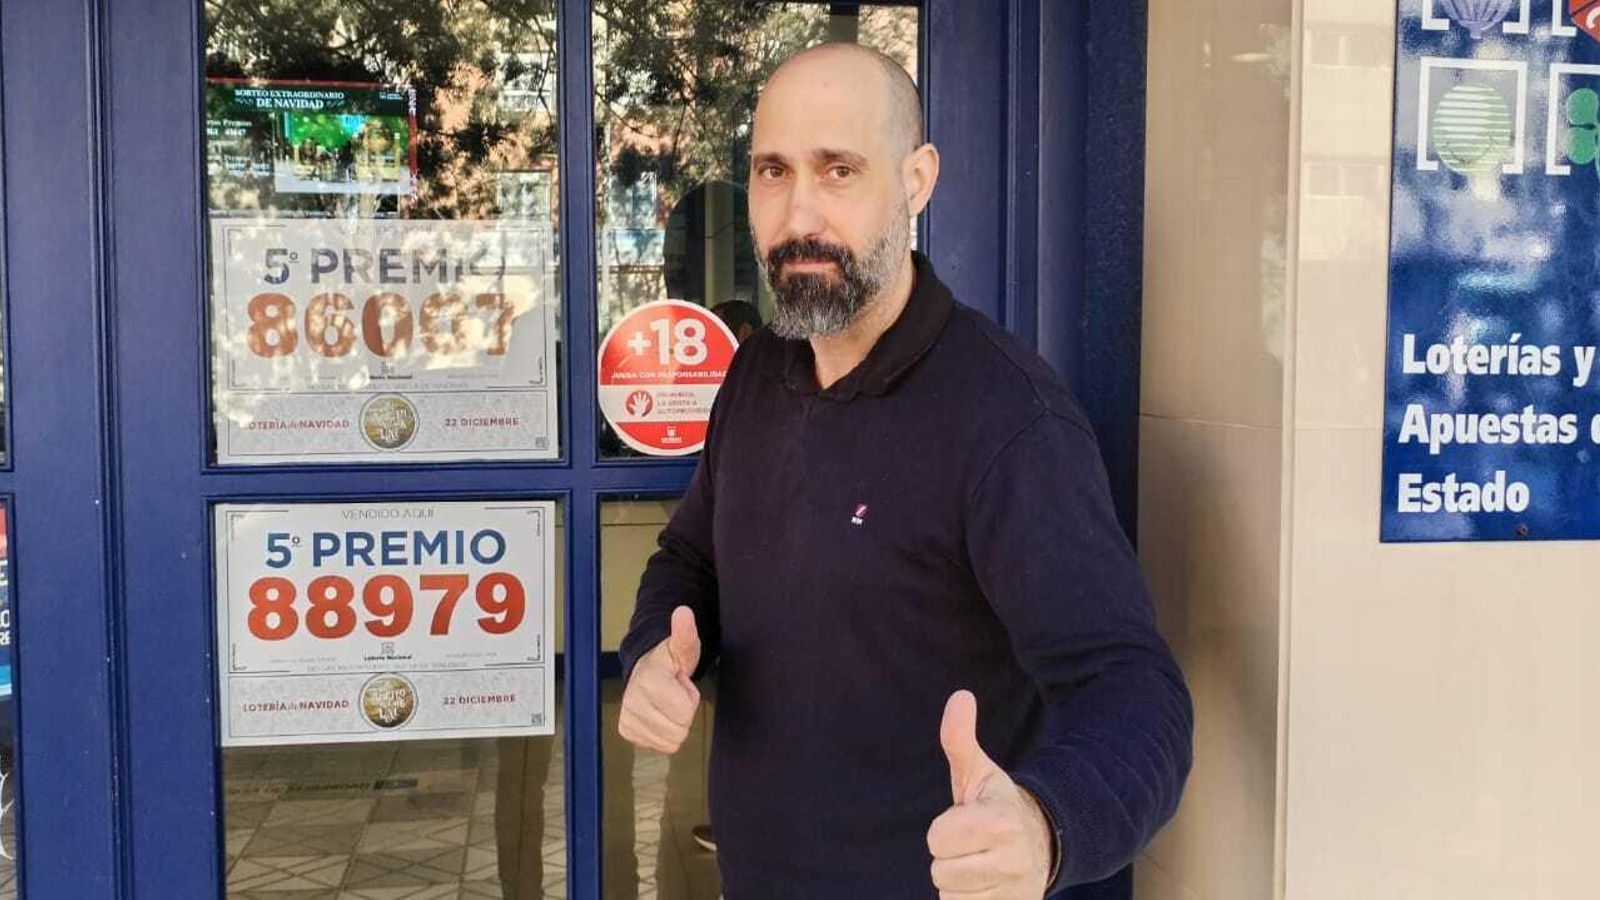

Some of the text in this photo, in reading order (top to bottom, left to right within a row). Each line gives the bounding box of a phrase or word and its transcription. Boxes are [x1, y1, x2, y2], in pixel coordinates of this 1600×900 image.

[234, 89, 345, 99] SORTEO EXTRAORDINARIO
[256, 98, 325, 109] DE NAVIDAD
[311, 248, 506, 284] PREMIO
[626, 317, 709, 366] +18
[1402, 333, 1596, 388] Loterías y
[248, 416, 289, 431] OTERÍA
[300, 418, 350, 430] NAVIDAD
[444, 417, 520, 427] 22 DICIEMBRE
[1398, 404, 1578, 455] Apuestas
[1397, 470, 1530, 512] Estado
[342, 509, 400, 520] VENDIDO
[312, 529, 506, 568] PREMIO
[247, 572, 526, 641] 88979
[243, 699, 288, 713] LOTERÍA
[300, 699, 350, 710] NAVIDAD
[443, 693, 516, 705] 22 DICIEMBRE
